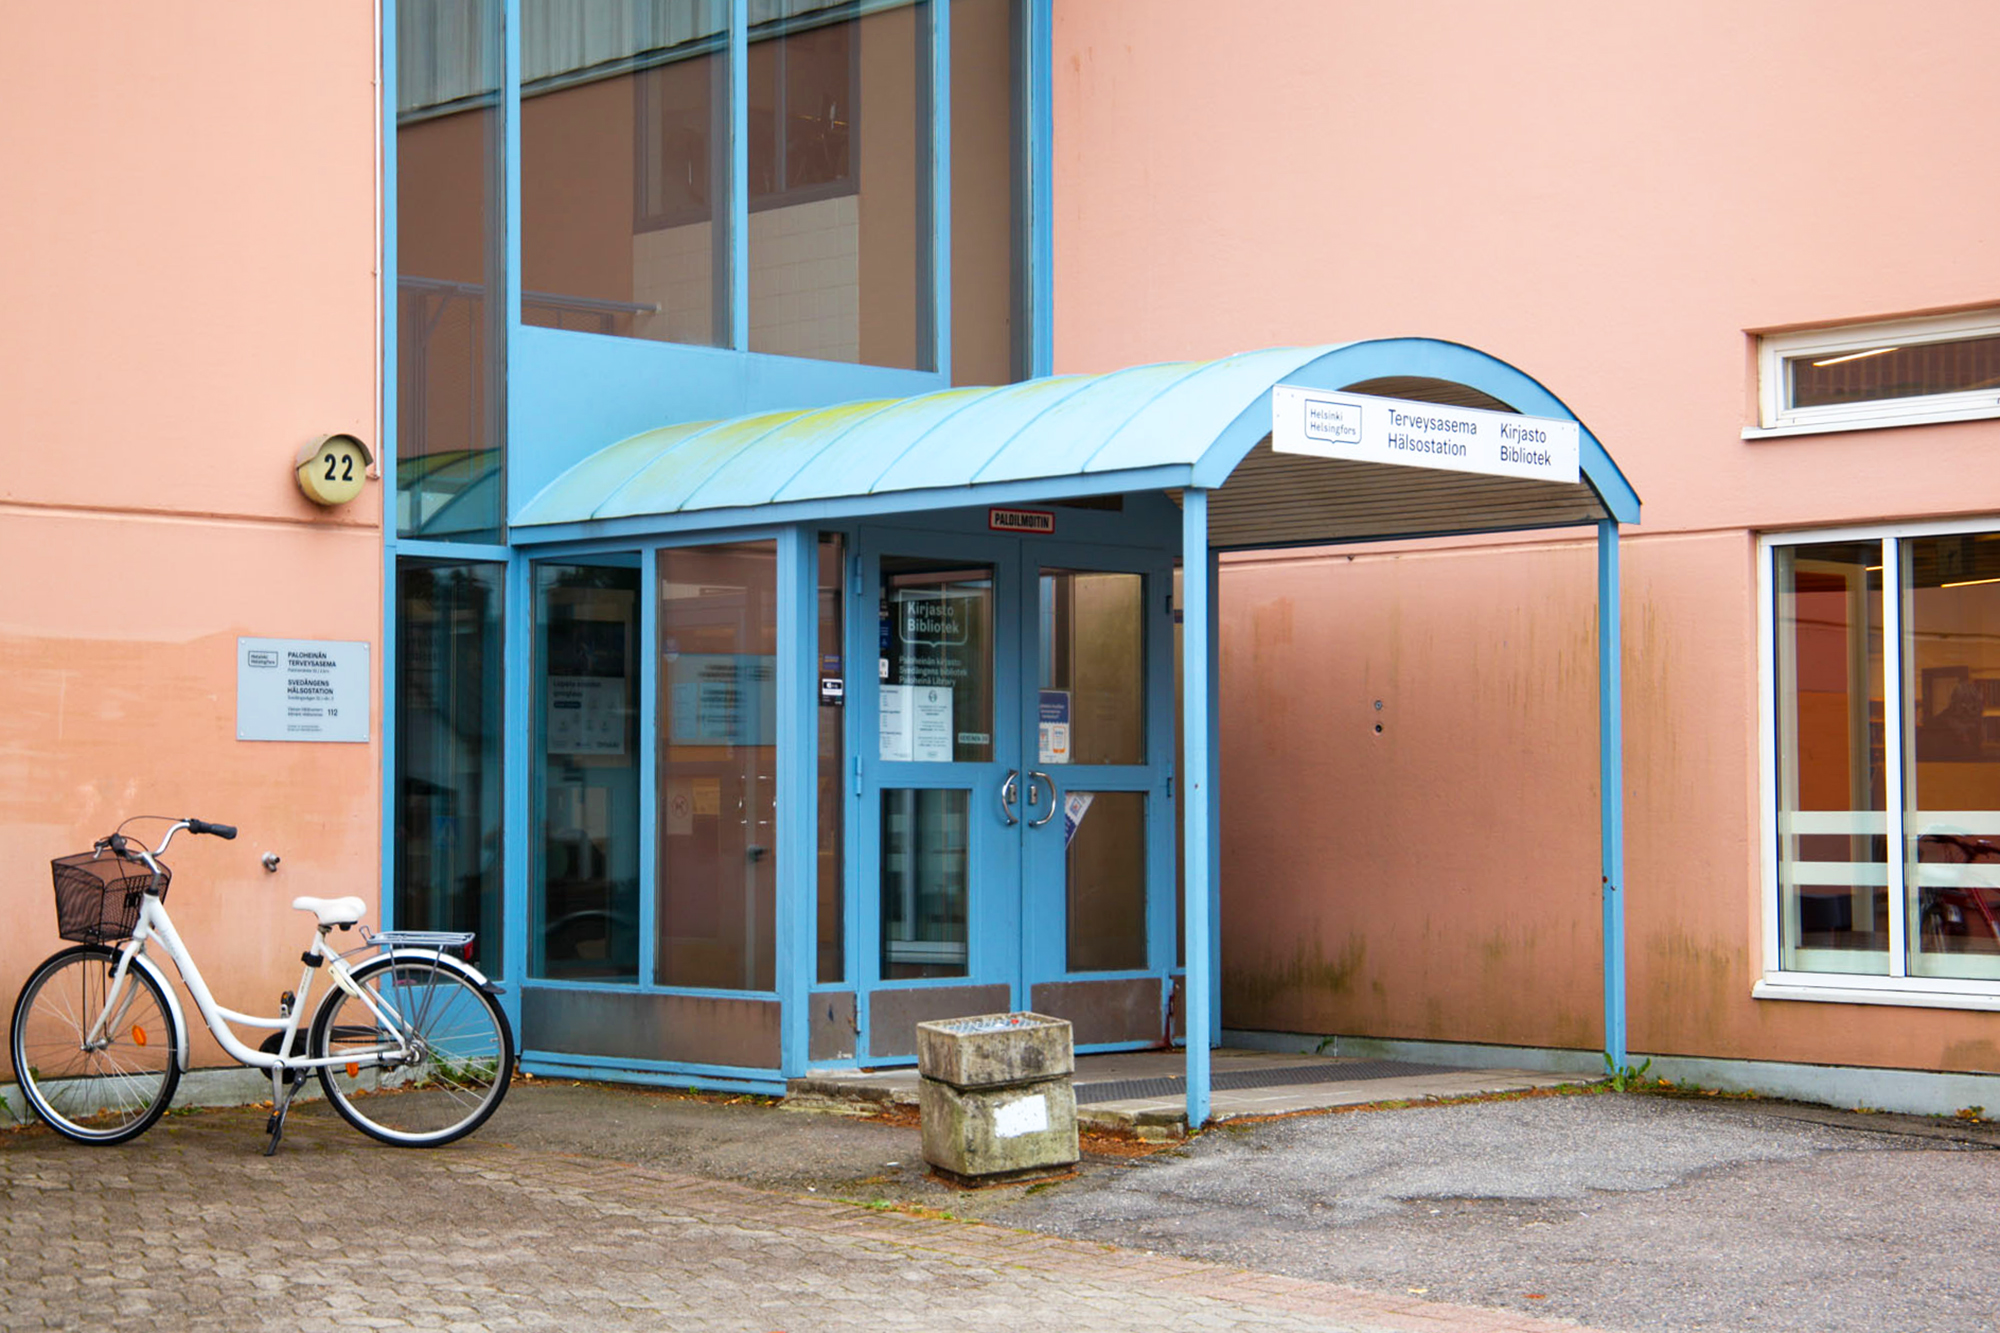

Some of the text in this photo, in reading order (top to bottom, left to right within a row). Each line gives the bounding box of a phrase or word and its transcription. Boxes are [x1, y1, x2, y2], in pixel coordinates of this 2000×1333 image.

[1310, 409, 1344, 421] Helsinki
[1388, 408, 1478, 435] Terveysasema
[1310, 421, 1356, 437] Helsingfors
[1500, 422, 1547, 445] Kirjasto
[1388, 432, 1467, 456] Hälsostation
[1500, 445, 1552, 466] Bibliotek
[323, 454, 353, 482] 22
[994, 512, 1050, 528] PALOILMOITIN
[907, 601, 954, 618] Kirjasto
[907, 618, 960, 634] Bibliotek
[288, 651, 326, 659] PALOHEINÄN
